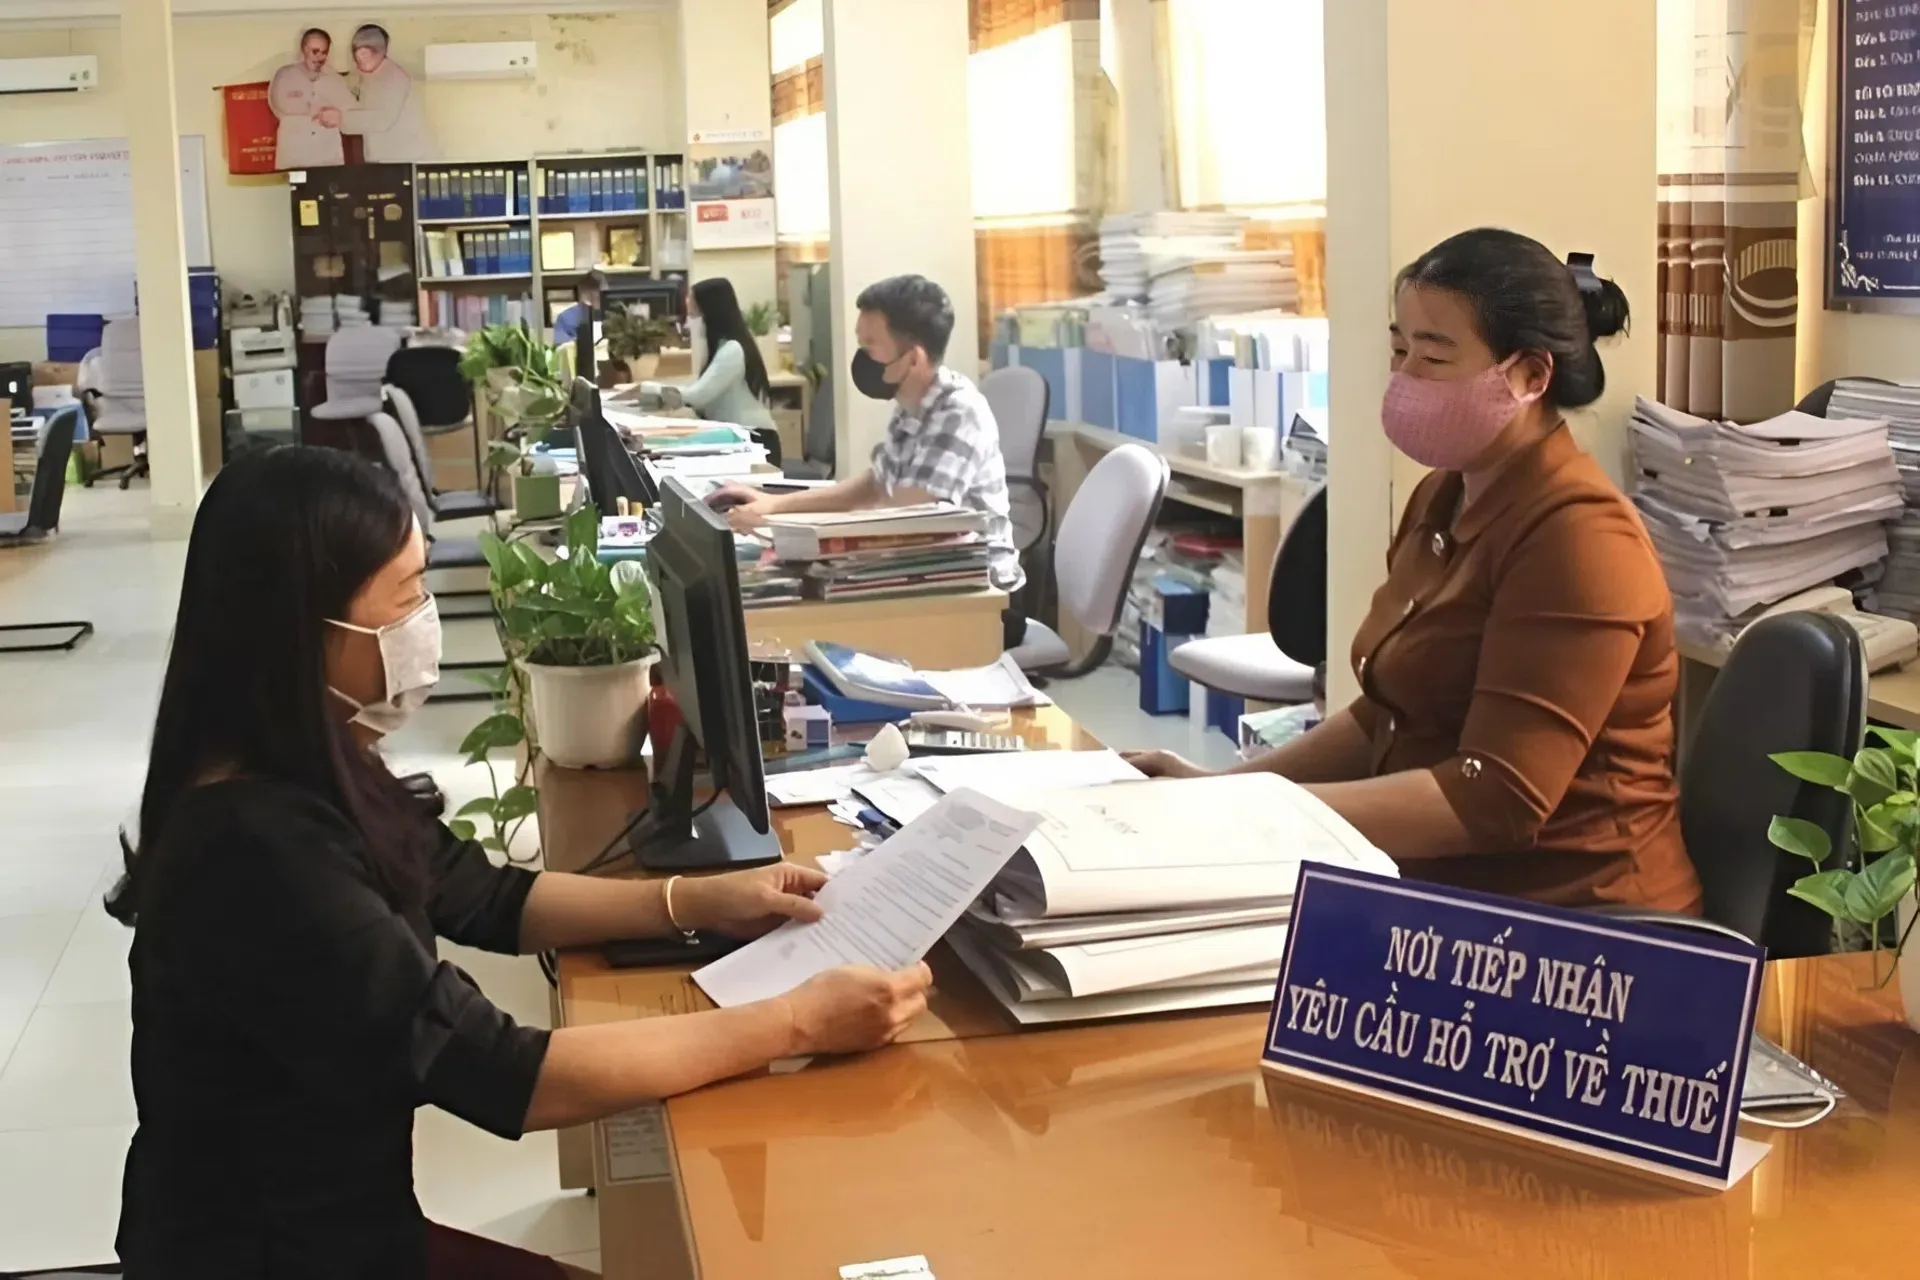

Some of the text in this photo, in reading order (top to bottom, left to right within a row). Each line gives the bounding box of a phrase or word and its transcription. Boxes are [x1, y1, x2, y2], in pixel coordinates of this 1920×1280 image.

[1384, 926, 1635, 1027] NƠI TIẾP NHẬN
[1287, 977, 1728, 1134] YÊU CẦU HỖ TRỢ VỀ THUẾ
